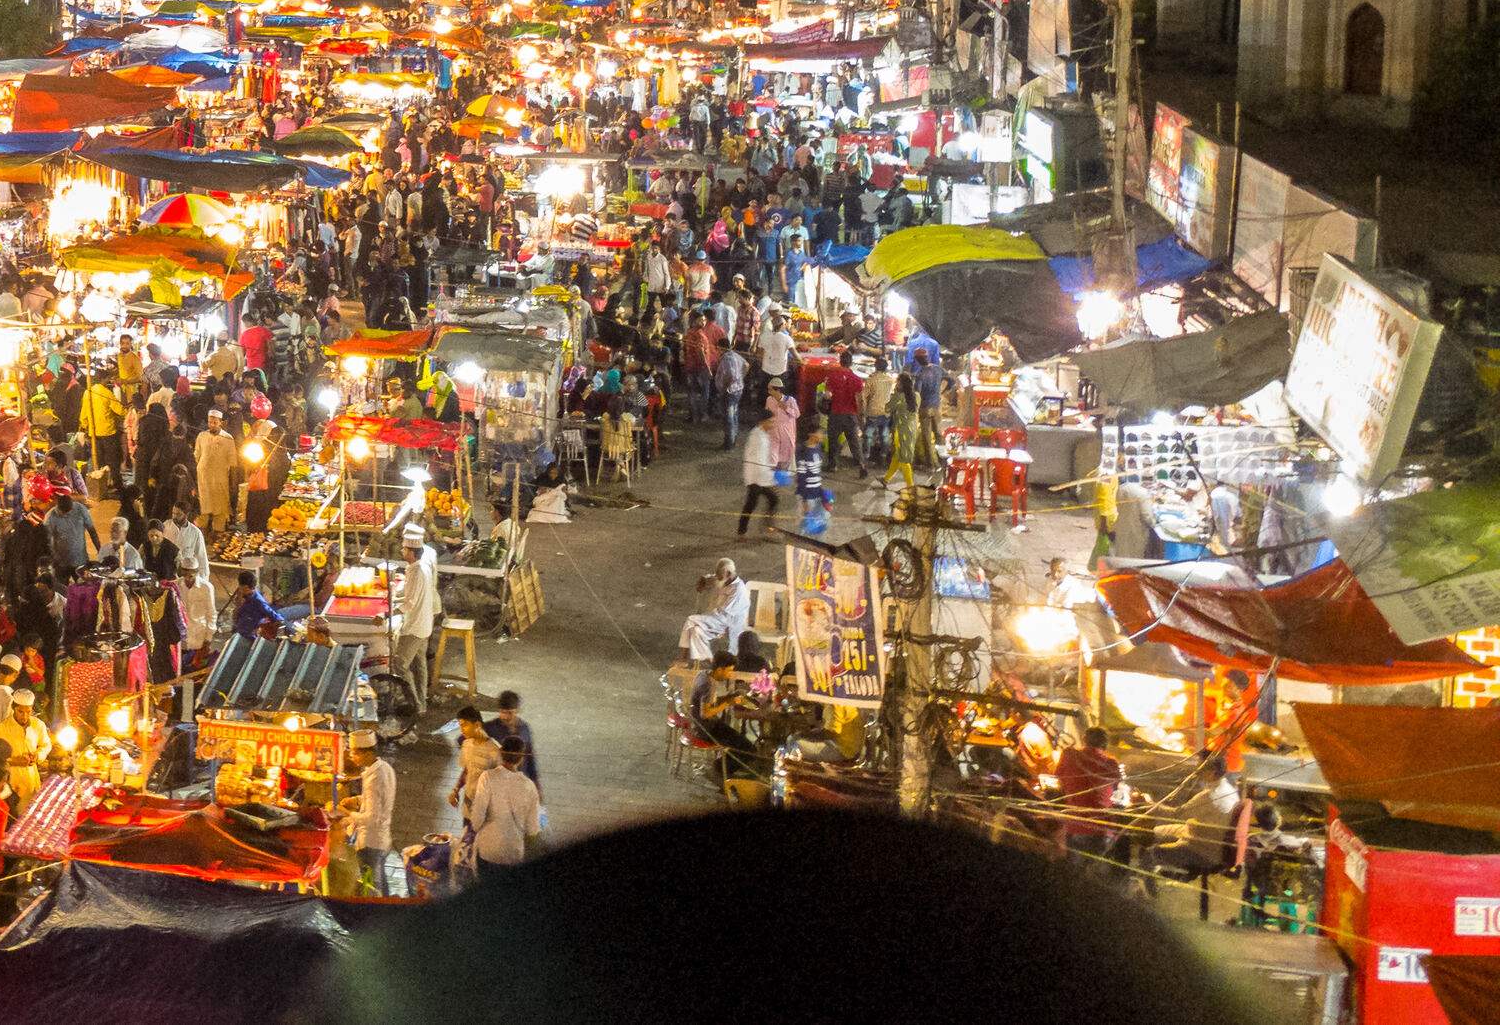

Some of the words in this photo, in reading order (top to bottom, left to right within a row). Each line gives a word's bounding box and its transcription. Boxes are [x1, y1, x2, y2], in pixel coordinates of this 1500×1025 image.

[202, 725, 264, 742] HYDERABADI
[267, 732, 312, 745] CHICKEN
[259, 744, 296, 767] 10/-
